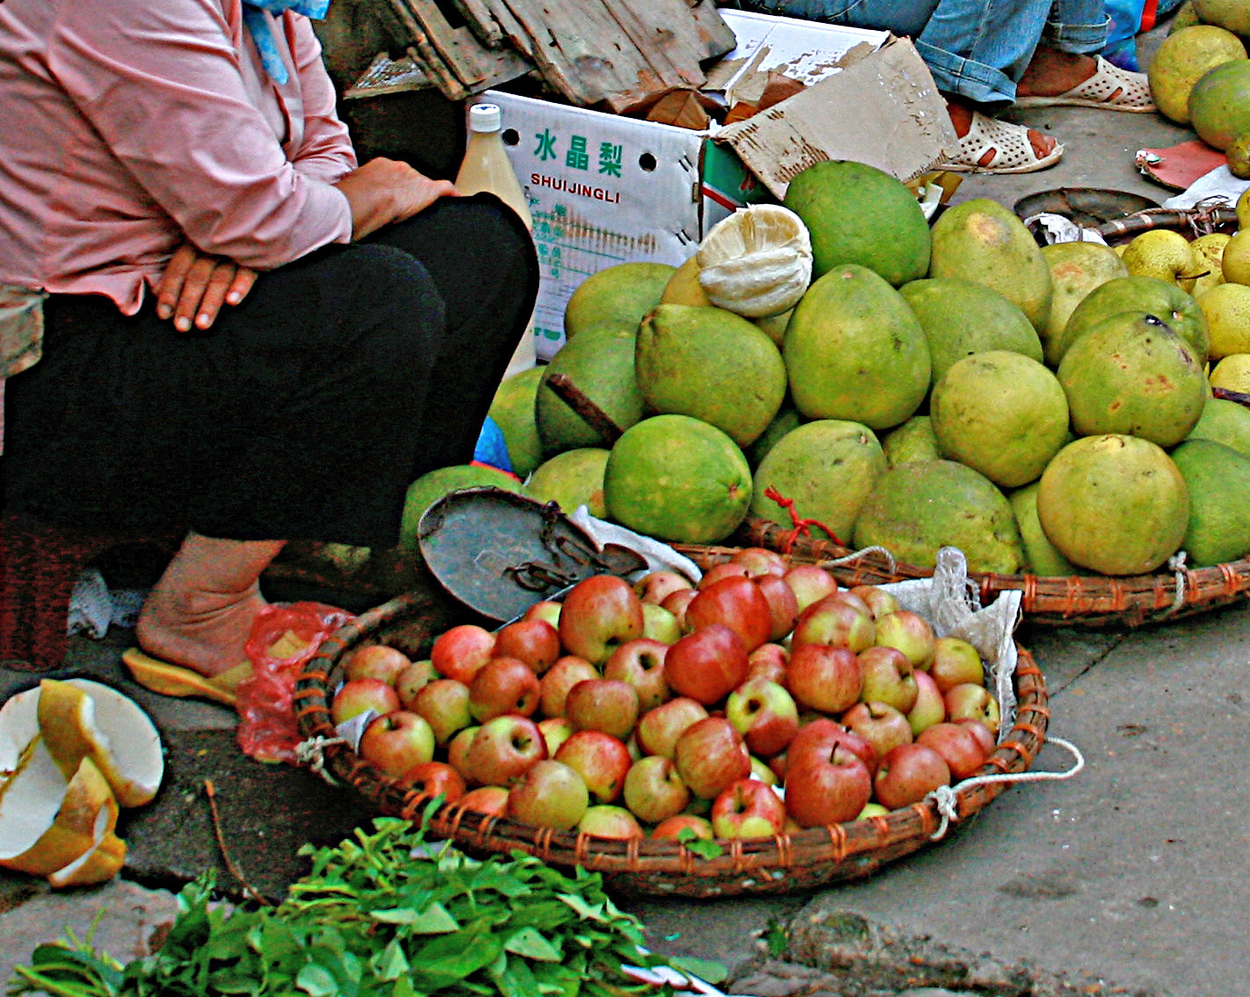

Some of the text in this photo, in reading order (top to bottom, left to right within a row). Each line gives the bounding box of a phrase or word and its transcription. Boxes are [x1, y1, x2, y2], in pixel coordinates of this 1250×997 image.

[533, 128, 623, 179] 水晶梨
[530, 172, 620, 204] SHUIJINGLI
